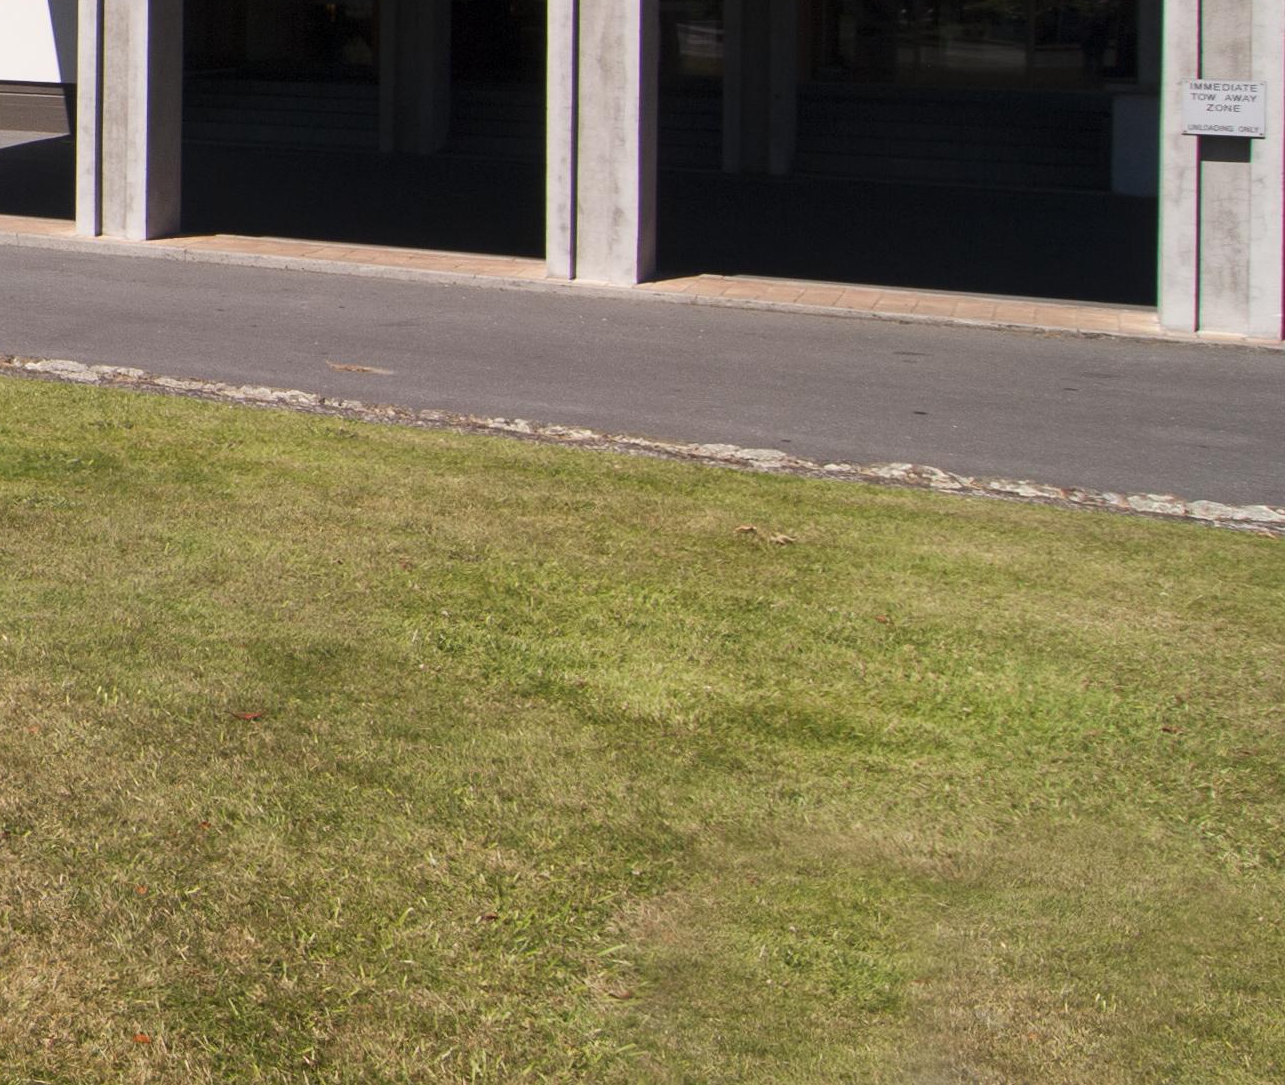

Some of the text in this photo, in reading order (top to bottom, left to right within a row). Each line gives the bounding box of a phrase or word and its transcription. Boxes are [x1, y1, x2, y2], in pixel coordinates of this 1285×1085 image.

[1189, 82, 1258, 93] IMMEDIATE
[1190, 93, 1257, 102] TOW AWAY
[1206, 103, 1241, 113] ZONE
